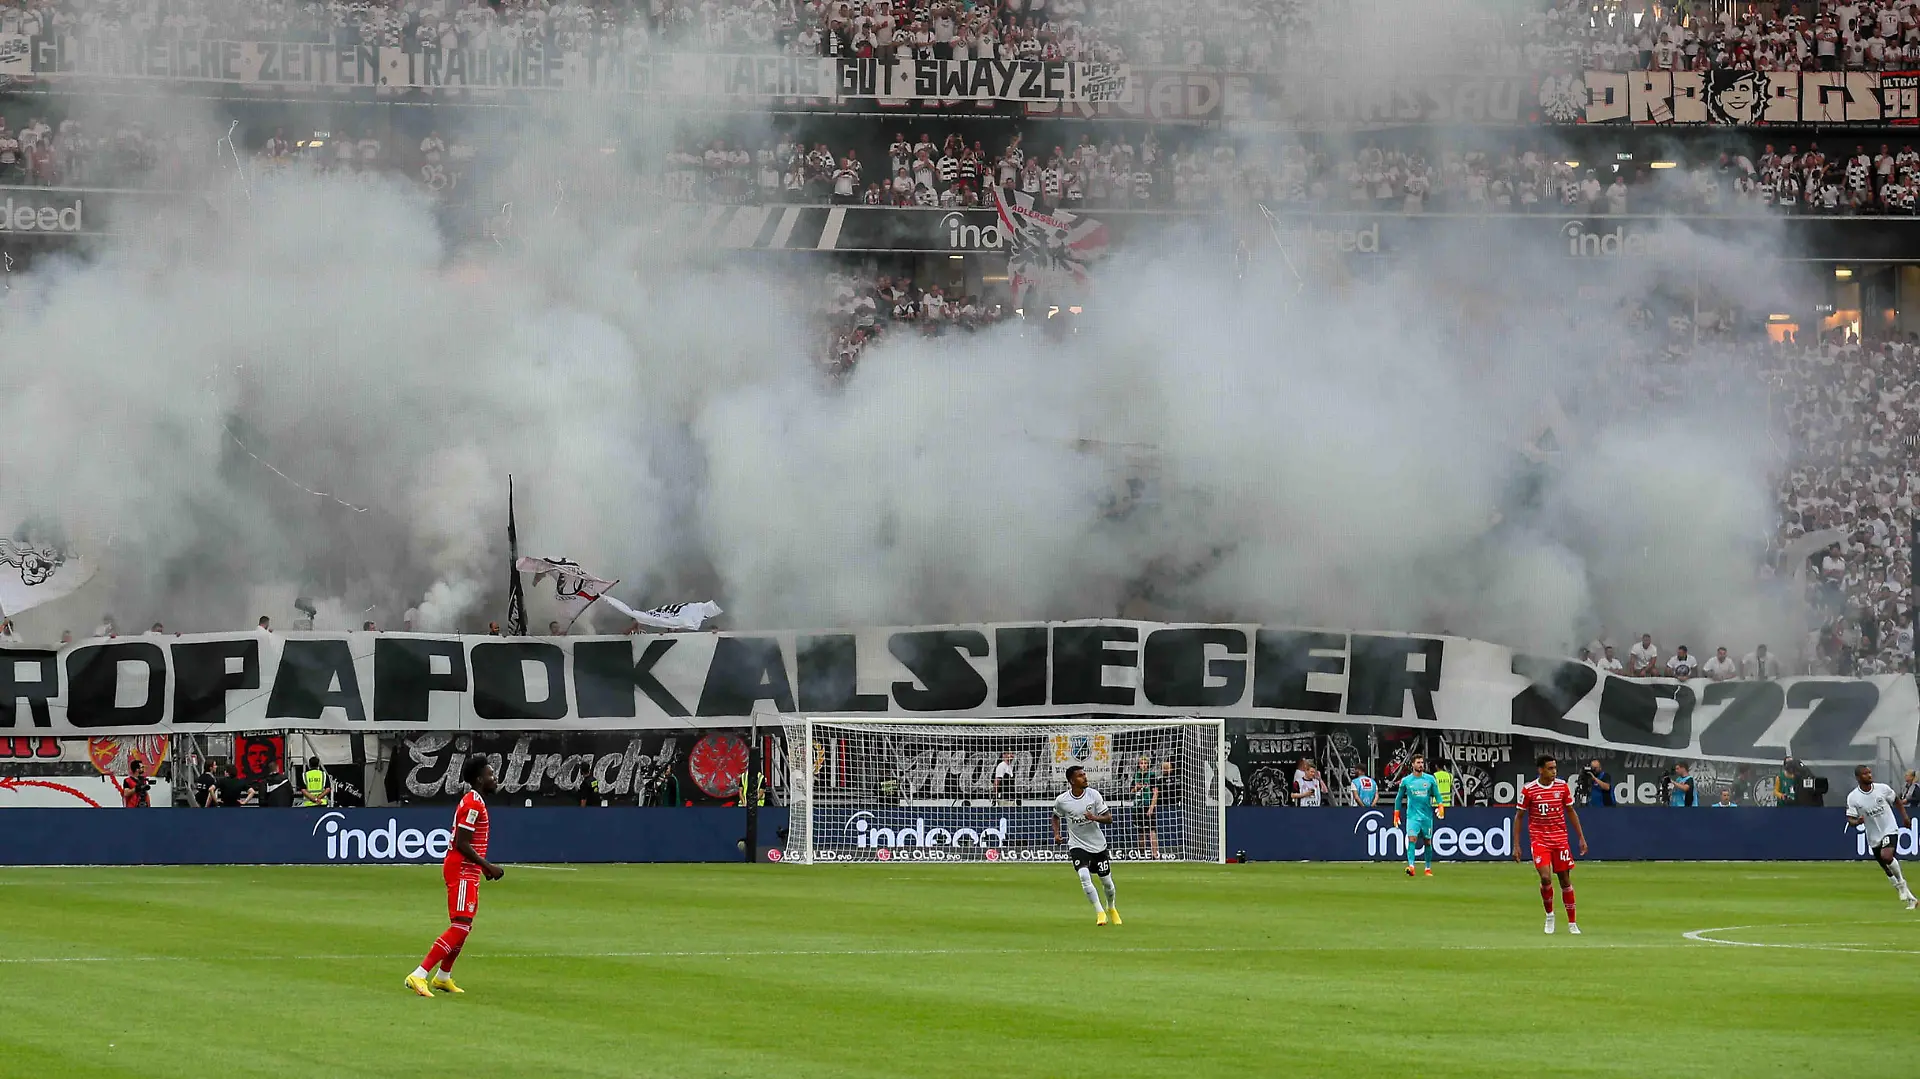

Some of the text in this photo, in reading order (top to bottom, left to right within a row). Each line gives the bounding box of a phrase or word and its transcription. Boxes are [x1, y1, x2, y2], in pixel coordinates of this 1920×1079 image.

[31, 36, 242, 81] GLREICHE
[258, 42, 379, 84] ZEITEN
[402, 48, 563, 88] TRAURIGE
[837, 59, 899, 96] GUT
[915, 60, 1075, 99] SWAYZE!
[1081, 76, 1126, 96] MOTOR
[1883, 77, 1918, 87] ULTRAS
[1089, 91, 1122, 101] CITY
[1884, 88, 1917, 117] 99
[949, 218, 1003, 248] ind
[1568, 225, 1664, 257] indee
[1512, 656, 1879, 761] 2022
[1443, 744, 1512, 765] VERBOT
[325, 818, 451, 859] indee
[856, 818, 1007, 848] indeed
[783, 851, 799, 860] LG
[893, 850, 909, 860] LG
[913, 850, 945, 860] OLED
[1002, 850, 1019, 860] LG
[1021, 850, 1052, 860] OLED
[1560, 849, 1570, 861] 42
[1098, 861, 1109, 872] 36
